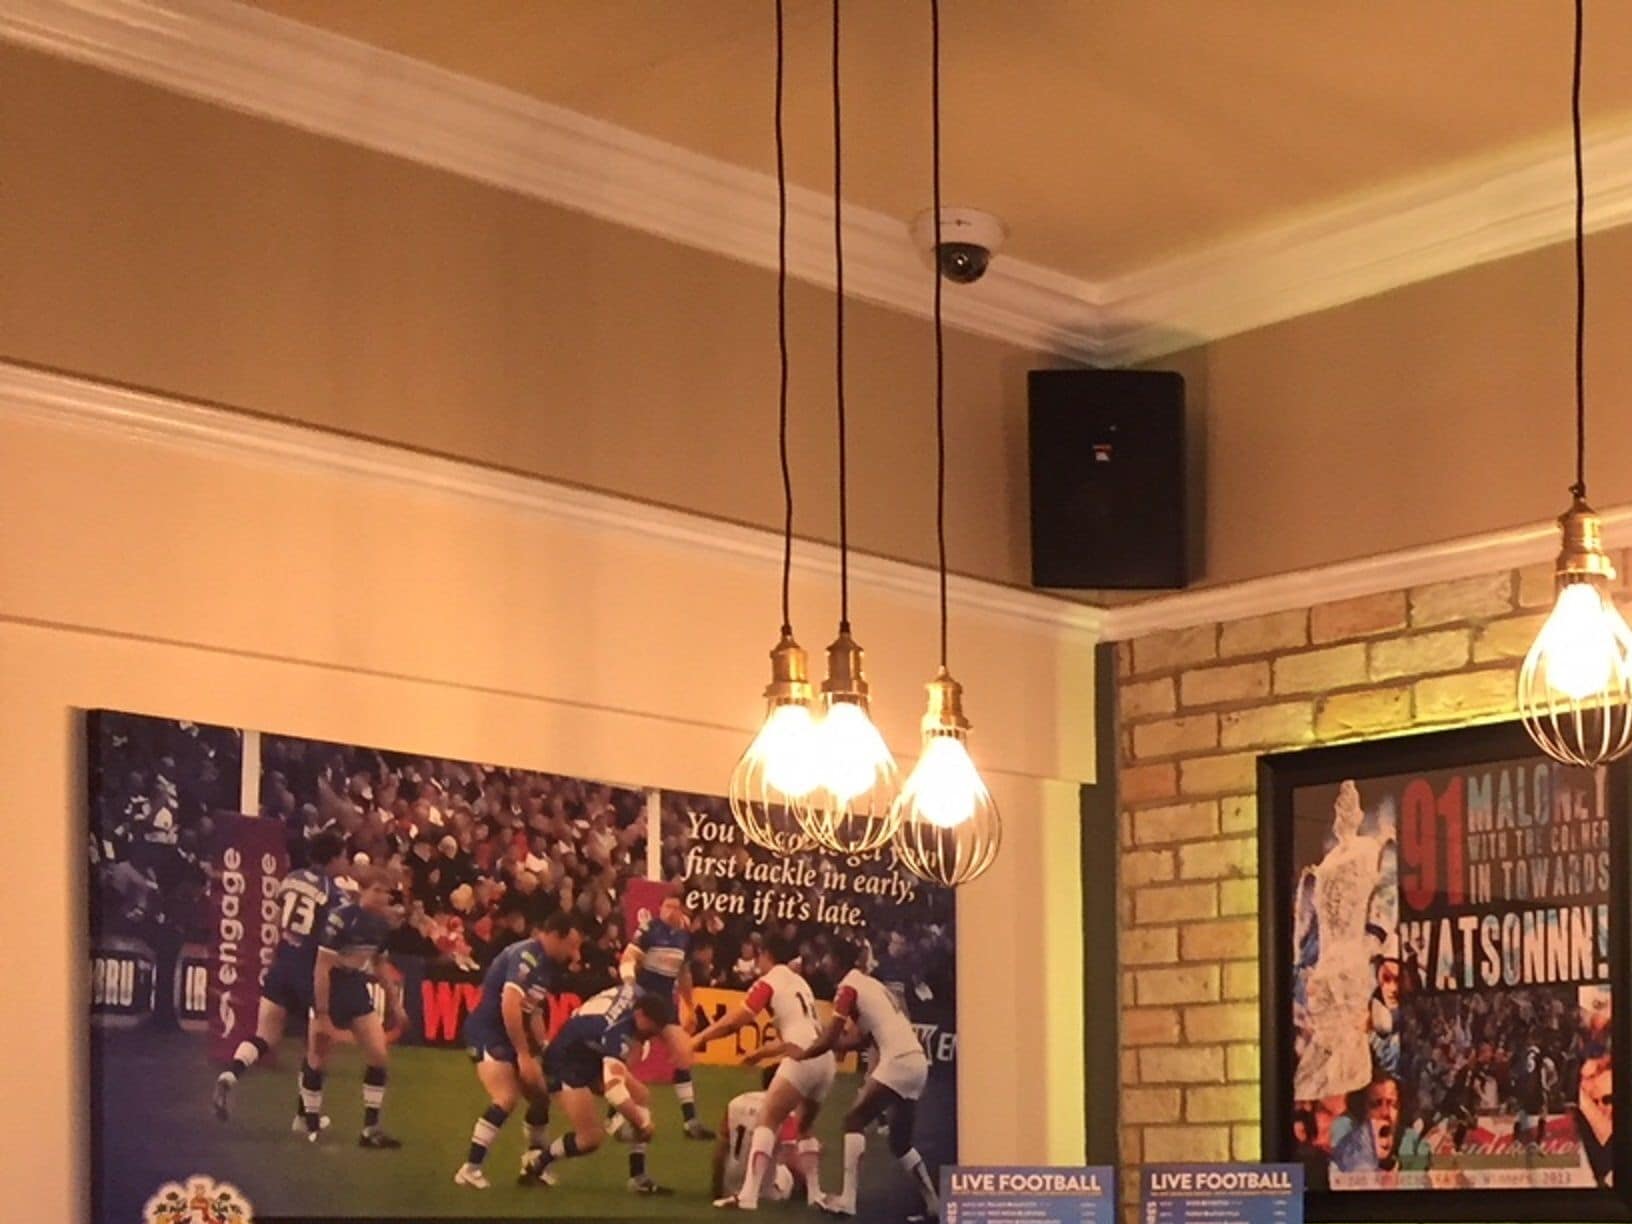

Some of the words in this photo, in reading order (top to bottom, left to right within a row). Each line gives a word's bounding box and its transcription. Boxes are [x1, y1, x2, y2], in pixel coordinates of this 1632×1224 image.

[1401, 776, 1464, 911] 91
[1467, 831, 1507, 861] WITH
[681, 846, 736, 882] first
[744, 859, 817, 888] tackle
[823, 867, 847, 892] in
[853, 872, 916, 905] early,
[1469, 863, 1492, 904] IN
[1501, 851, 1610, 901] TOWARDS
[219, 847, 245, 985] engage
[281, 890, 315, 936] 13
[685, 889, 745, 916] even
[753, 889, 773, 925] if
[777, 891, 811, 921] it's
[817, 895, 866, 928] late.
[1400, 903, 1609, 991] WATSONNN!
[951, 1173, 995, 1191] LIVE
[999, 1174, 1102, 1191] FOOTBALL
[1151, 1172, 1192, 1190] LIVE
[1196, 1172, 1292, 1189] FOOTBALL
